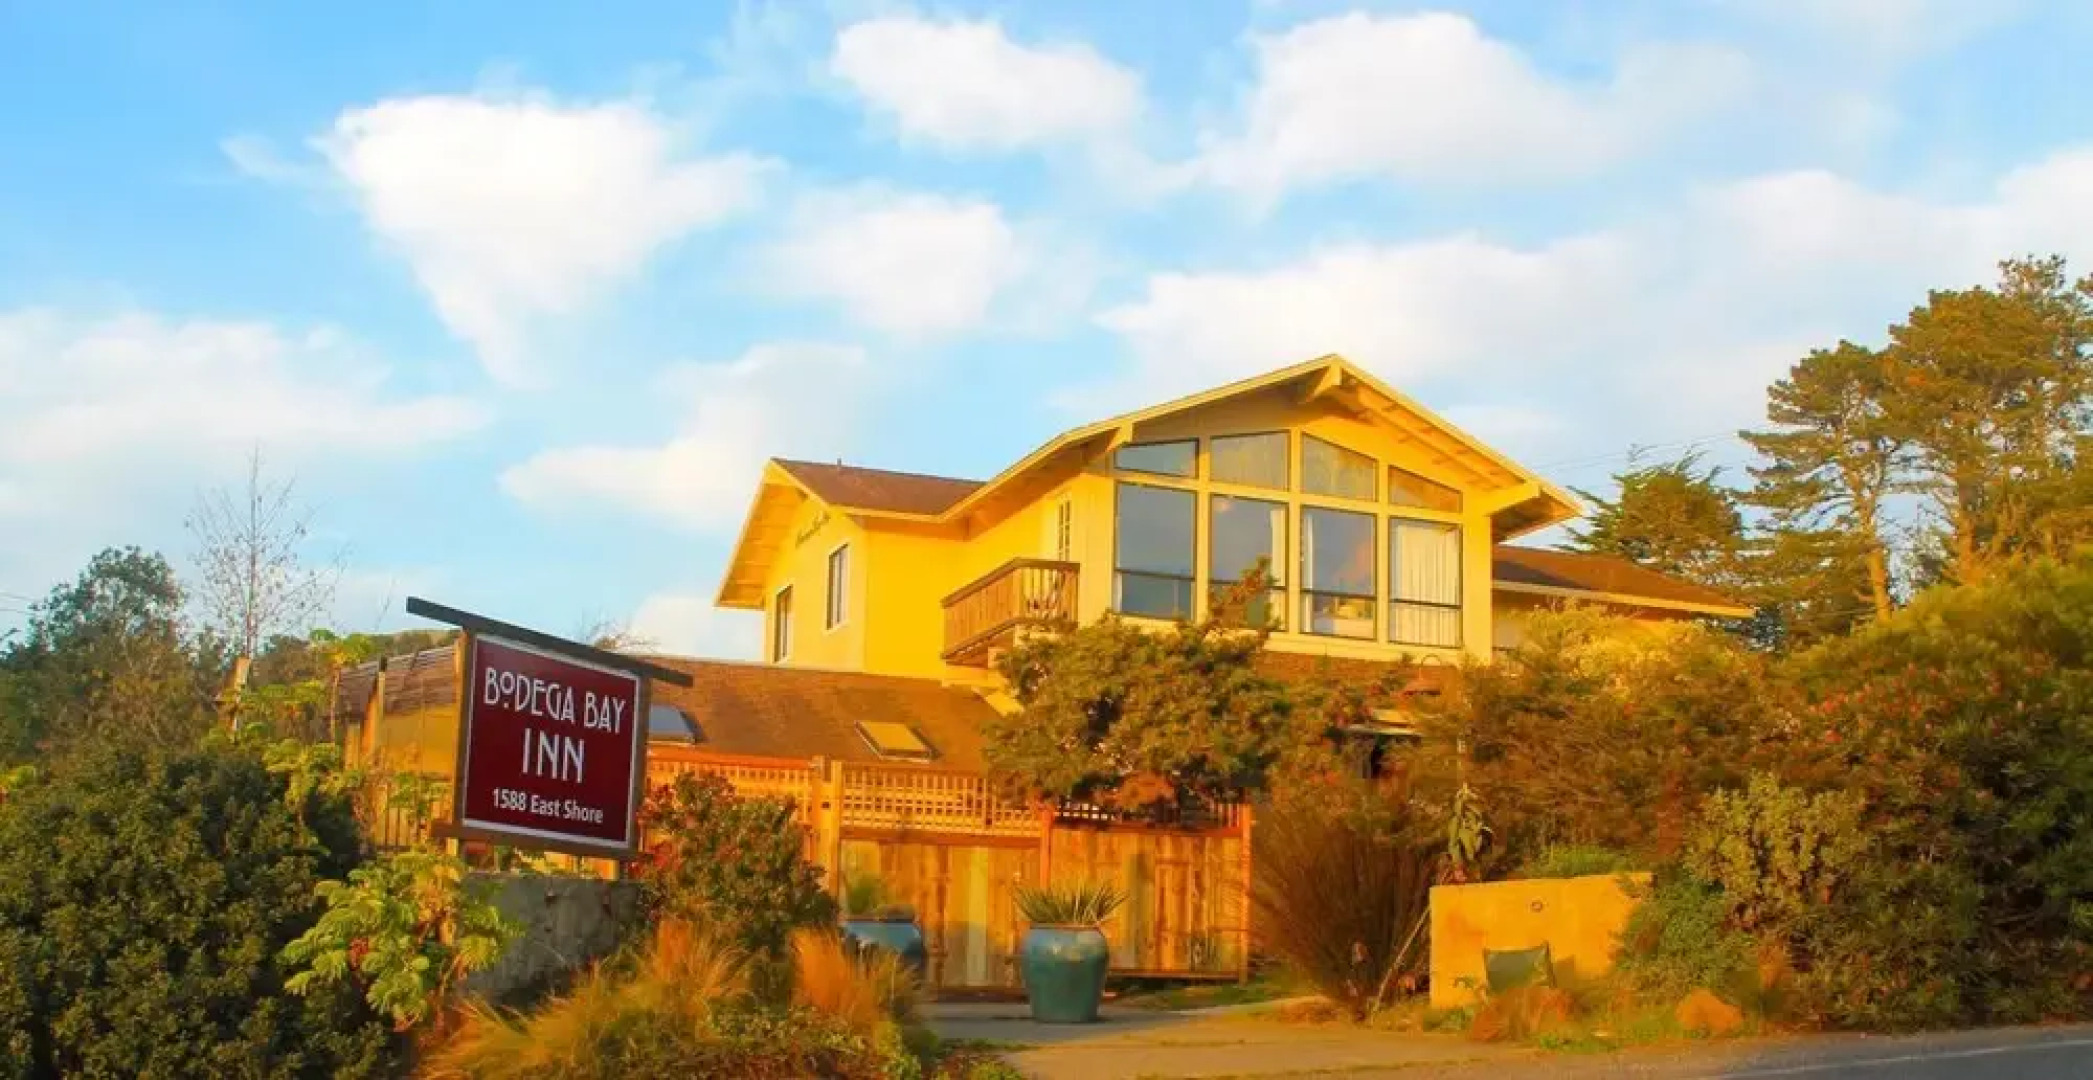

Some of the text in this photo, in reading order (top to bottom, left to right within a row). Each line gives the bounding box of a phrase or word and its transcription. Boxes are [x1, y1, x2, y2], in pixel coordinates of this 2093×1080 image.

[484, 667, 626, 734] BODEGA BAY
[522, 728, 585, 783] INN
[492, 787, 604, 824] 1588 East Shore
